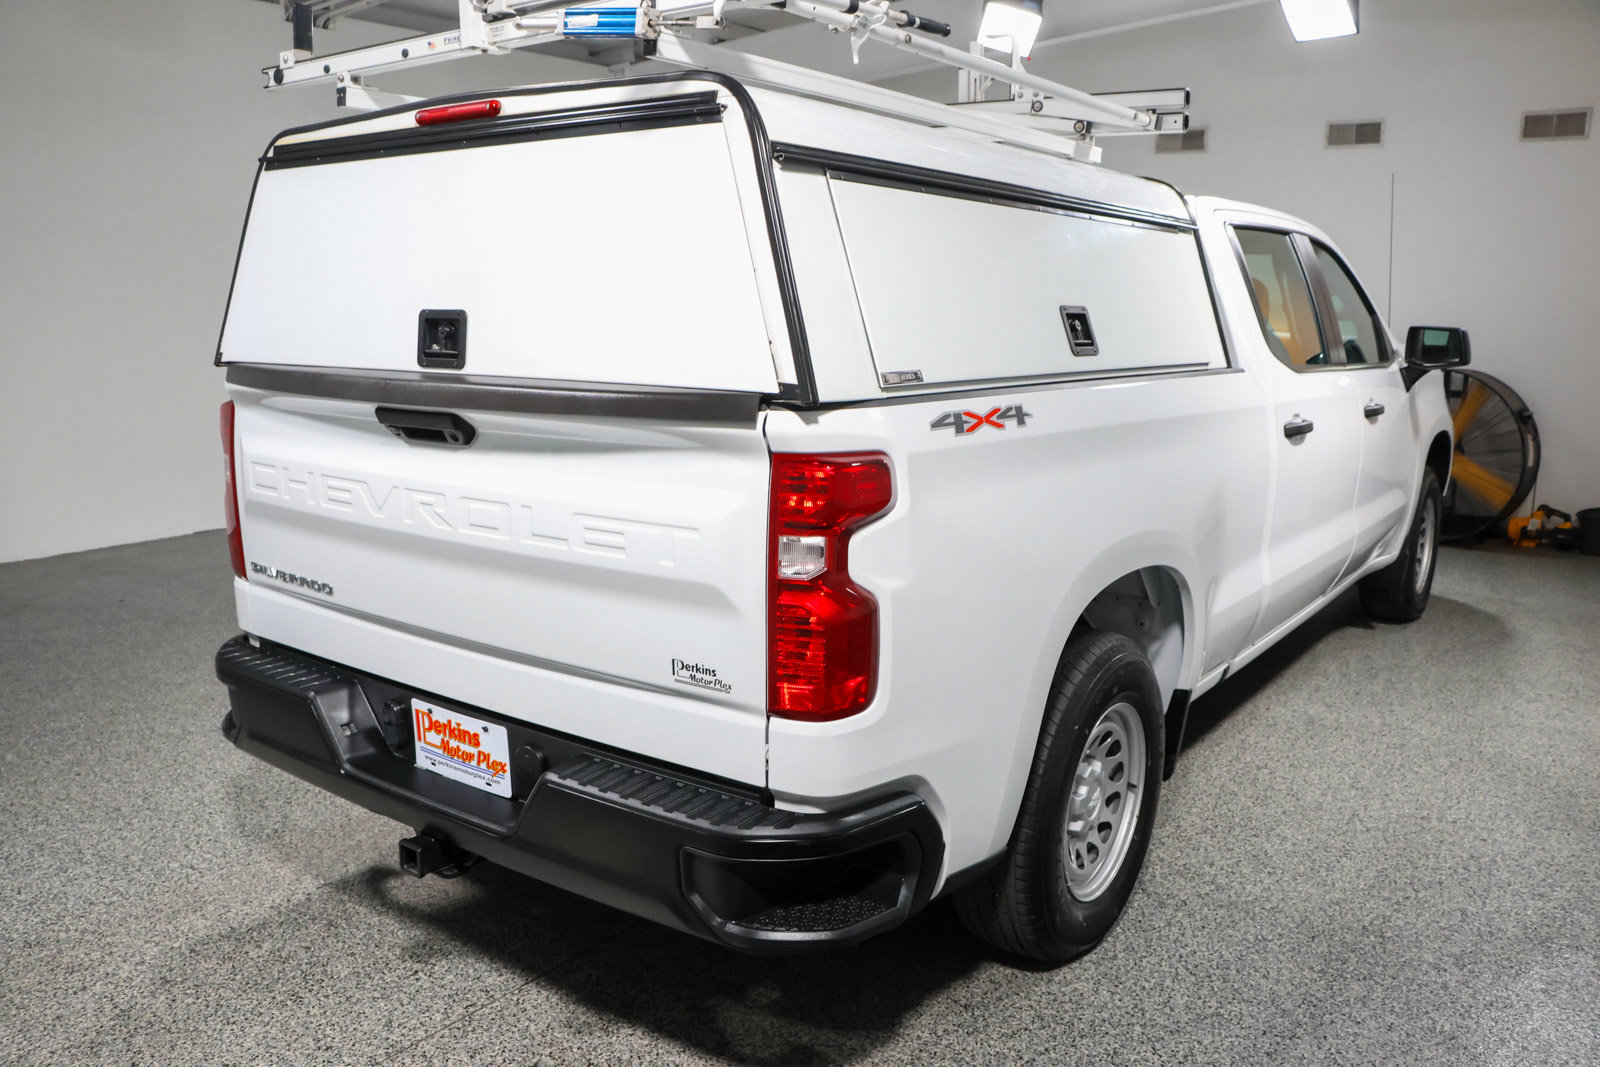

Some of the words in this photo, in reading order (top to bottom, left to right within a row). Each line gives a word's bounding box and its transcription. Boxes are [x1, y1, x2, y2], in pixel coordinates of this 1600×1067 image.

[249, 461, 701, 566] CHEVROLET
[250, 561, 334, 597] SILVERADO
[672, 658, 717, 678] Perkins
[415, 708, 481, 749] Perkins
[440, 738, 475, 763] Motor
[477, 750, 508, 778] Plex
